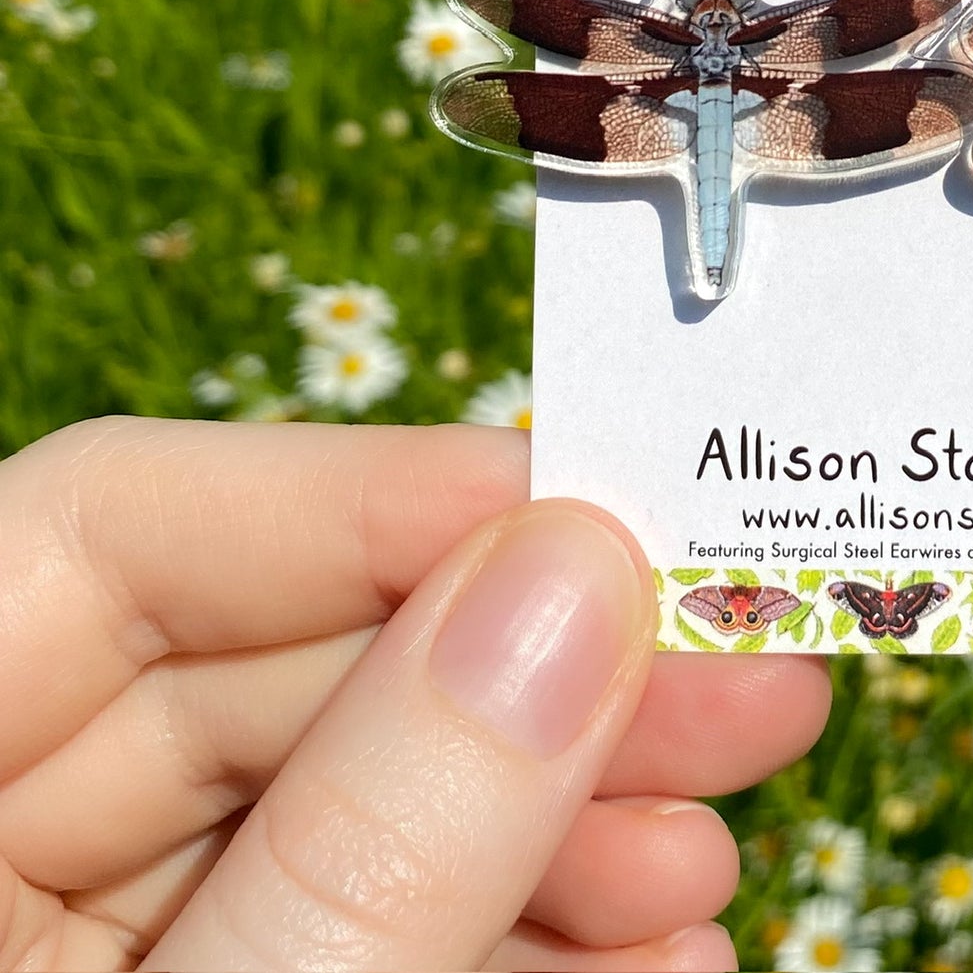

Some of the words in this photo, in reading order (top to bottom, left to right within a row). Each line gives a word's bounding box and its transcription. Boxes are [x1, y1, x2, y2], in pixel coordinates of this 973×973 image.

[697, 426, 878, 483] Allison
[689, 541, 763, 561] Featuring
[771, 541, 836, 562] Surgical
[844, 541, 882, 559] Steel
[890, 542, 960, 559] Earwires
